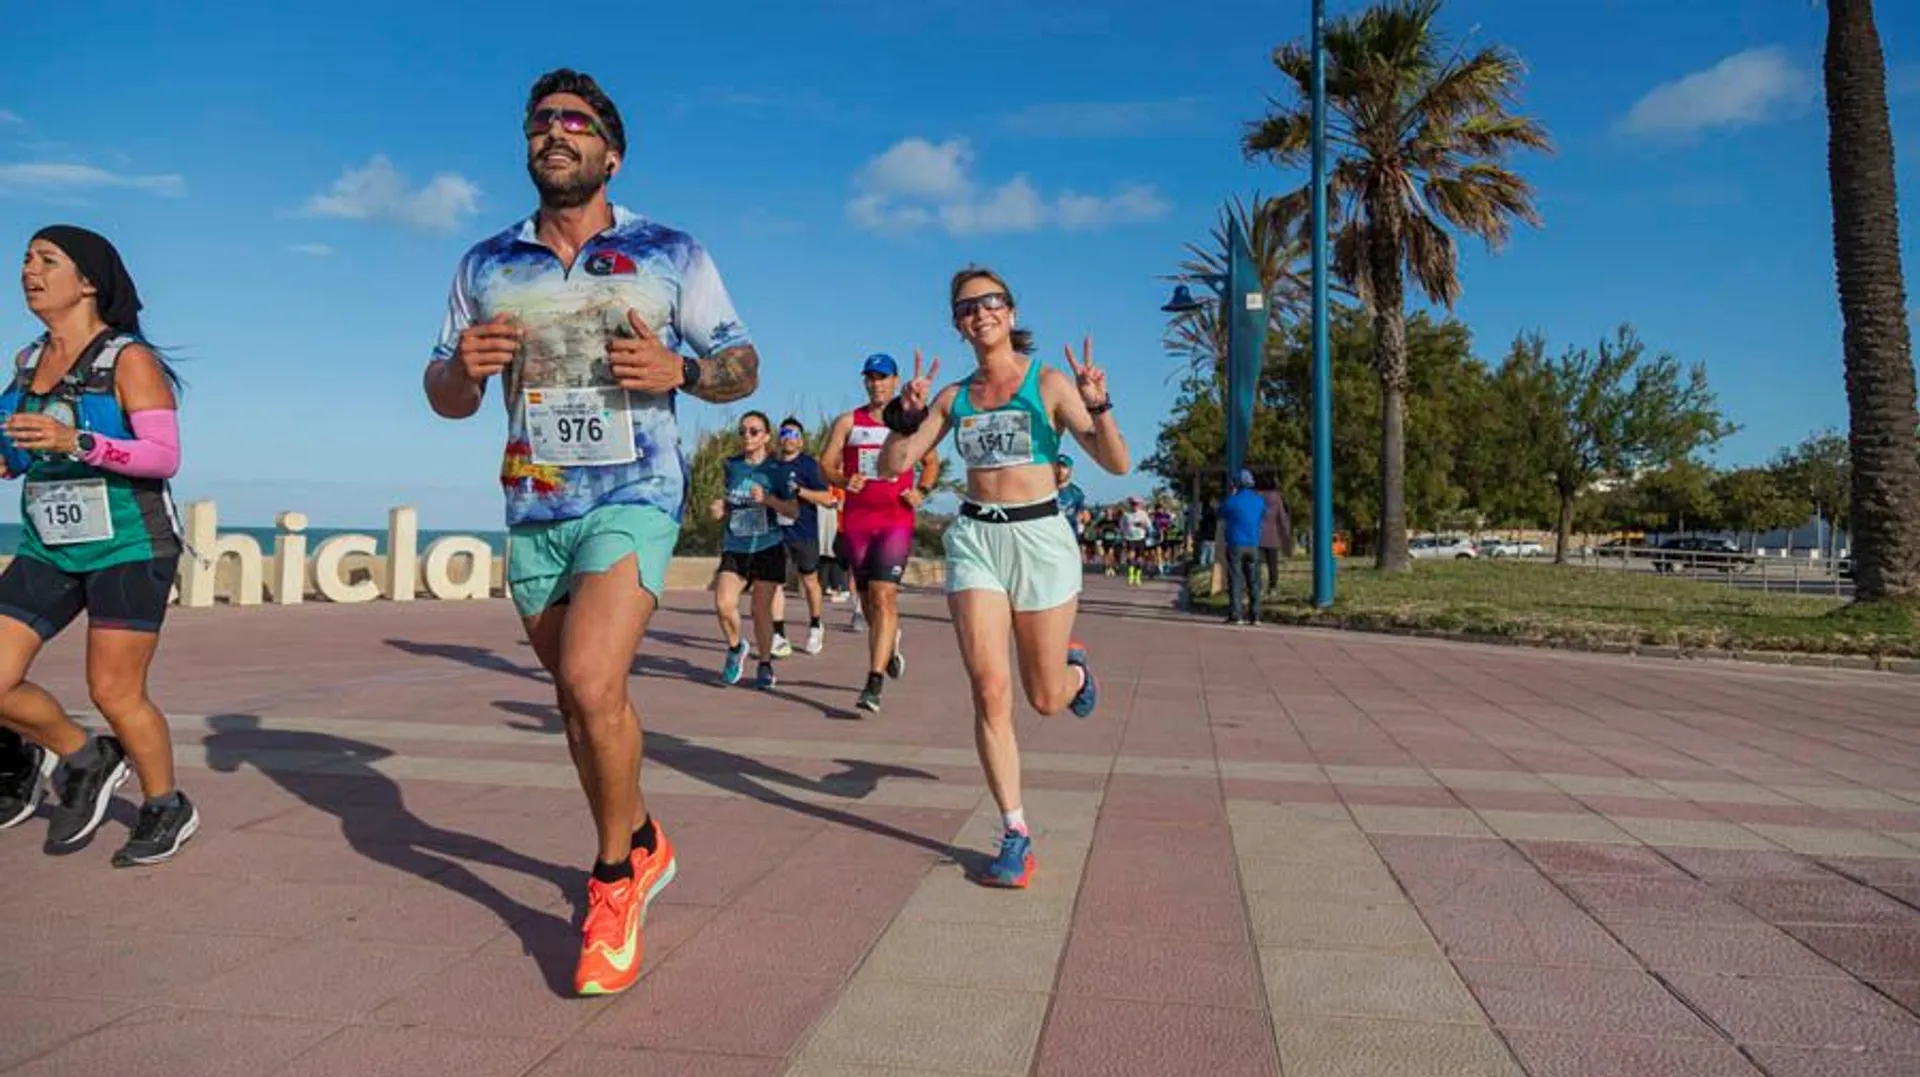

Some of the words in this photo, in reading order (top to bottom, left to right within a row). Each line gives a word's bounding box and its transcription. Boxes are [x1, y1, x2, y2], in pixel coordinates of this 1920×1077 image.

[557, 417, 604, 443] 976
[44, 503, 82, 525] 150
[169, 499, 514, 607] hicla
